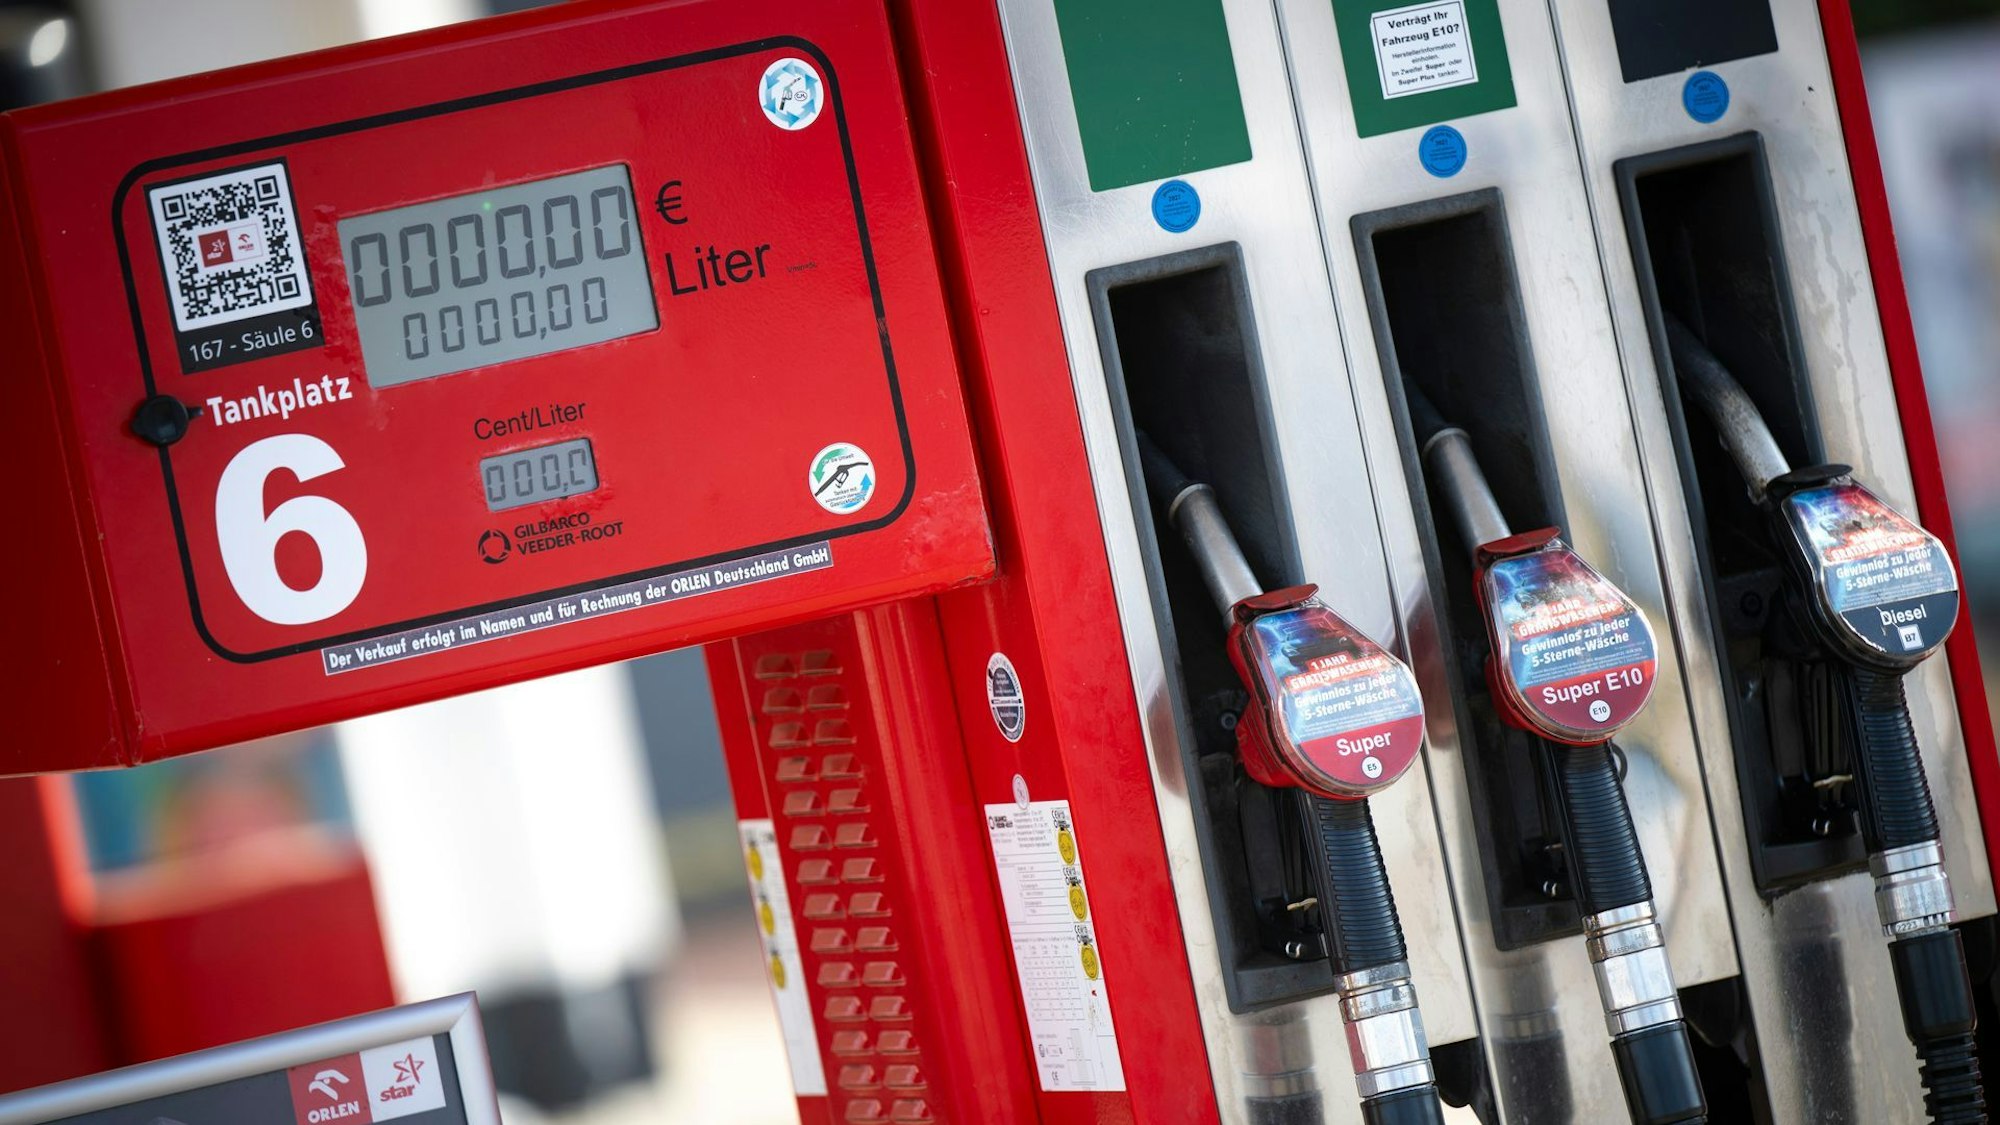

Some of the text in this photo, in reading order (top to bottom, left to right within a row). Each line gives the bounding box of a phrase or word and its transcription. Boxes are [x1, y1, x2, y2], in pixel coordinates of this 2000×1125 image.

[1388, 12, 1448, 28] Verträgt Ihr
[1382, 24, 1459, 46] Fahrzeug E10?
[1392, 43, 1456, 58] Herstellerinformation
[655, 180, 688, 224] €
[665, 244, 770, 296] Liter
[189, 340, 223, 362] 167
[242, 326, 296, 352] Säule
[301, 320, 314, 338] 6
[206, 374, 353, 426] Tankplatz
[474, 402, 586, 440] Cent/Liter
[215, 433, 368, 625] 6
[514, 512, 590, 538] GILBARCO
[517, 522, 623, 555] VEEDER-ROOT
[1836, 559, 1889, 578] Gewinnlos
[1890, 556, 1904, 566] zu
[1846, 562, 1932, 591] 5-Sterne-Wäsche
[329, 547, 829, 669] Der Verkauf erfolgt im Namen und für Rechnung der ORLEN Deutschland GmbH
[1880, 604, 1927, 626] Diesel
[1522, 618, 1630, 655] Gewinnlos zu jeder
[1532, 632, 1629, 667] 5-Sterne-Wäsche
[1905, 633, 1916, 642] B7
[1321, 654, 1348, 668] JAHR
[1295, 686, 1351, 707] Gewinnlos
[1353, 681, 1366, 693] zu
[1542, 680, 1601, 704] Super
[1605, 667, 1643, 691] E10
[1304, 687, 1397, 720] 5-Sterne-Wäsche
[1593, 706, 1607, 715] E10
[1336, 732, 1391, 756] Super
[1367, 763, 1377, 772] E5
[1896, 921, 1918, 932] 2223
[380, 1084, 415, 1102] star
[308, 1101, 360, 1124] ORLEN
